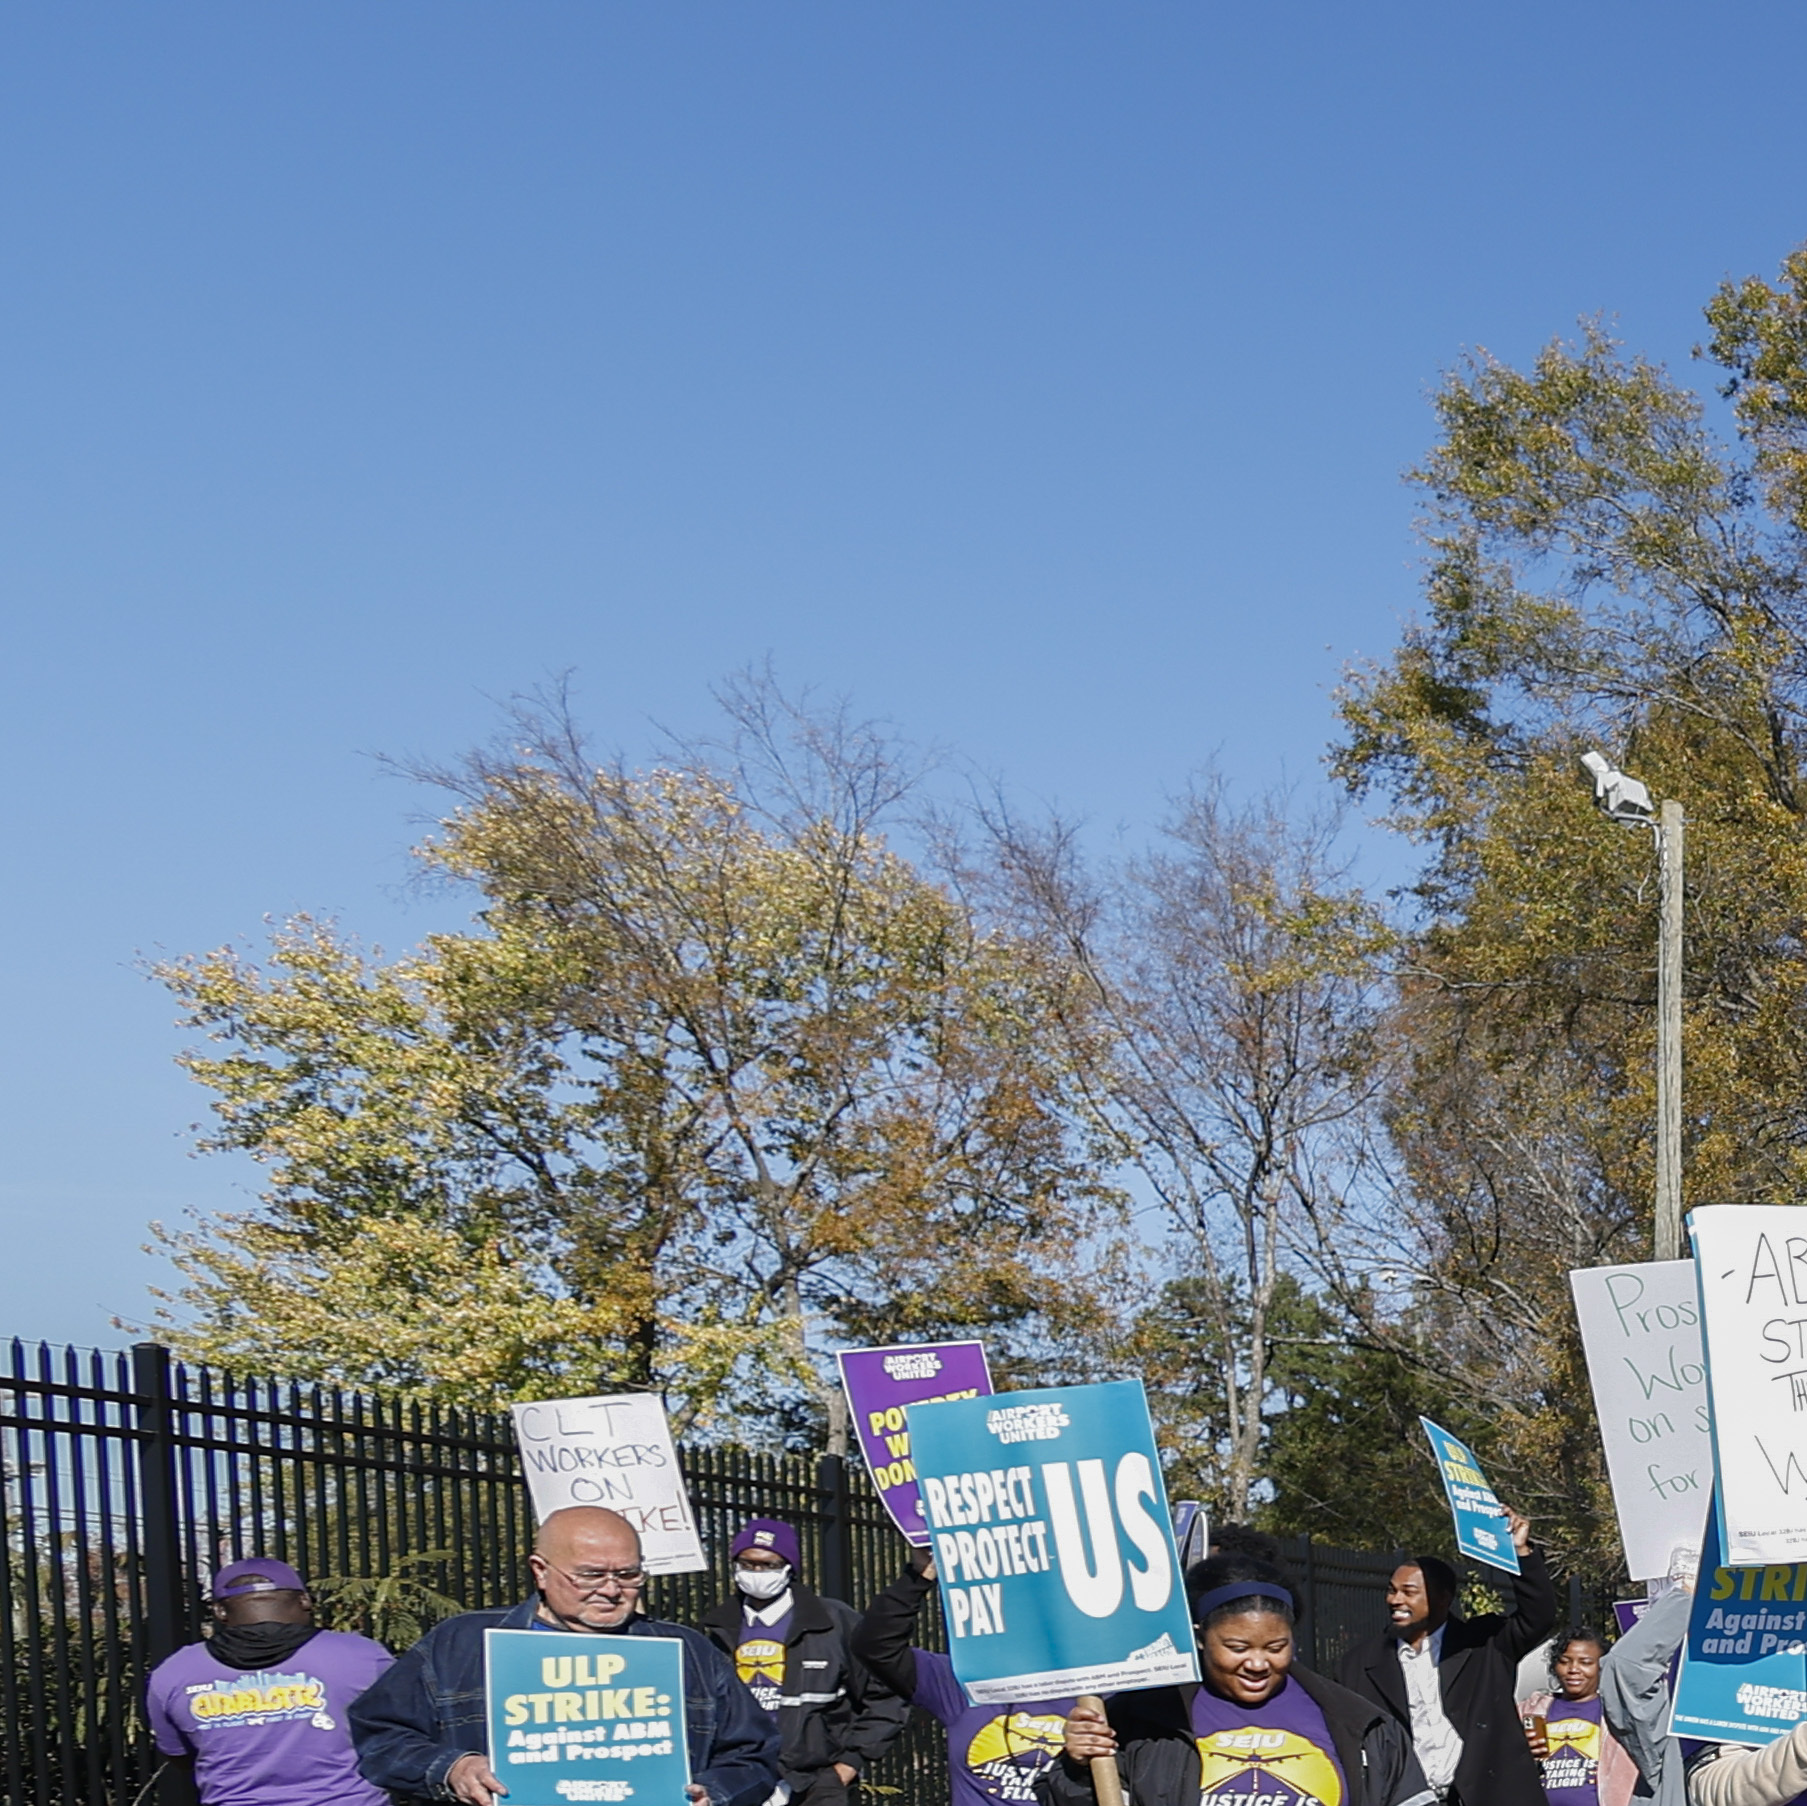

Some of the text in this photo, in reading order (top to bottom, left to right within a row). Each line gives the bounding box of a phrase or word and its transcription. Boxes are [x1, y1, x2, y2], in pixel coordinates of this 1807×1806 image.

[521, 1402, 632, 1442] CLT
[987, 1413, 1070, 1434] WORKERS
[990, 1403, 1062, 1422] AIRPORT
[1000, 1427, 1060, 1444] UNITED
[1629, 1412, 1674, 1443] on
[526, 1444, 667, 1473] WORKERS
[571, 1473, 634, 1502] ON
[1648, 1464, 1700, 1500] for
[923, 1452, 1172, 1618] RESPECT US
[936, 1520, 1050, 1583] PROTECT
[948, 1583, 1005, 1638] PAY
[1705, 1608, 1806, 1636] Against
[739, 1644, 778, 1657] SEIU
[1702, 1632, 1752, 1654] and
[542, 1653, 626, 1688] ULP
[504, 1687, 671, 1725] STRIKE:
[1744, 1703, 1800, 1720] UNITED
[507, 1721, 671, 1750] Against ABM
[1215, 1733, 1287, 1749] SEIU
[508, 1740, 673, 1764] and Prospect
[1543, 1758, 1596, 1769] USTICE IS
[1546, 1768, 1587, 1779] TAKING
[1546, 1777, 1587, 1789] FLIGHT
